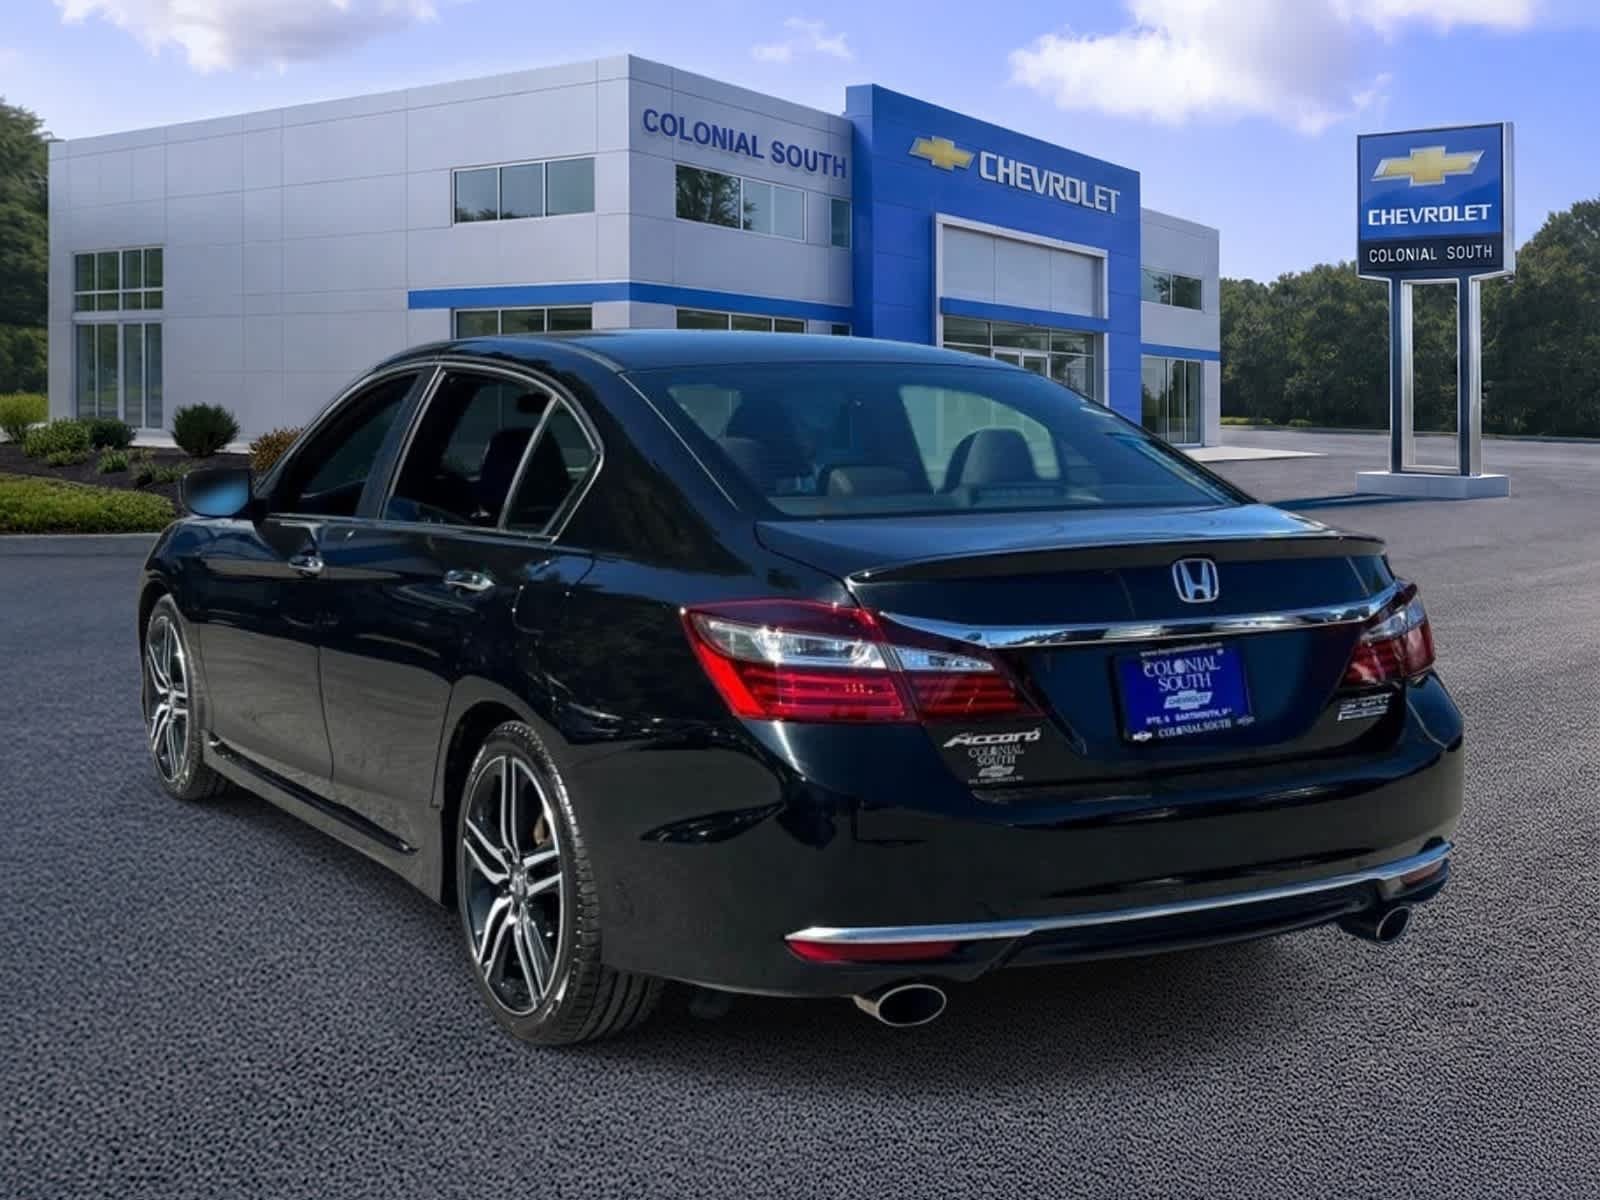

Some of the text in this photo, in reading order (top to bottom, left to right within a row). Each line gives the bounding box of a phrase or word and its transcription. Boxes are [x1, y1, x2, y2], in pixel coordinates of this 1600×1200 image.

[643, 108, 847, 179] COLONIAL SOUTH
[979, 151, 1121, 214] CHEVROLET
[1368, 204, 1492, 226] CHEVROLET
[1369, 244, 1493, 263] COLONIAL SOUTH
[1143, 655, 1221, 678] COLONIAL
[1158, 672, 1212, 692] SOUTH
[943, 727, 1041, 748] Accord
